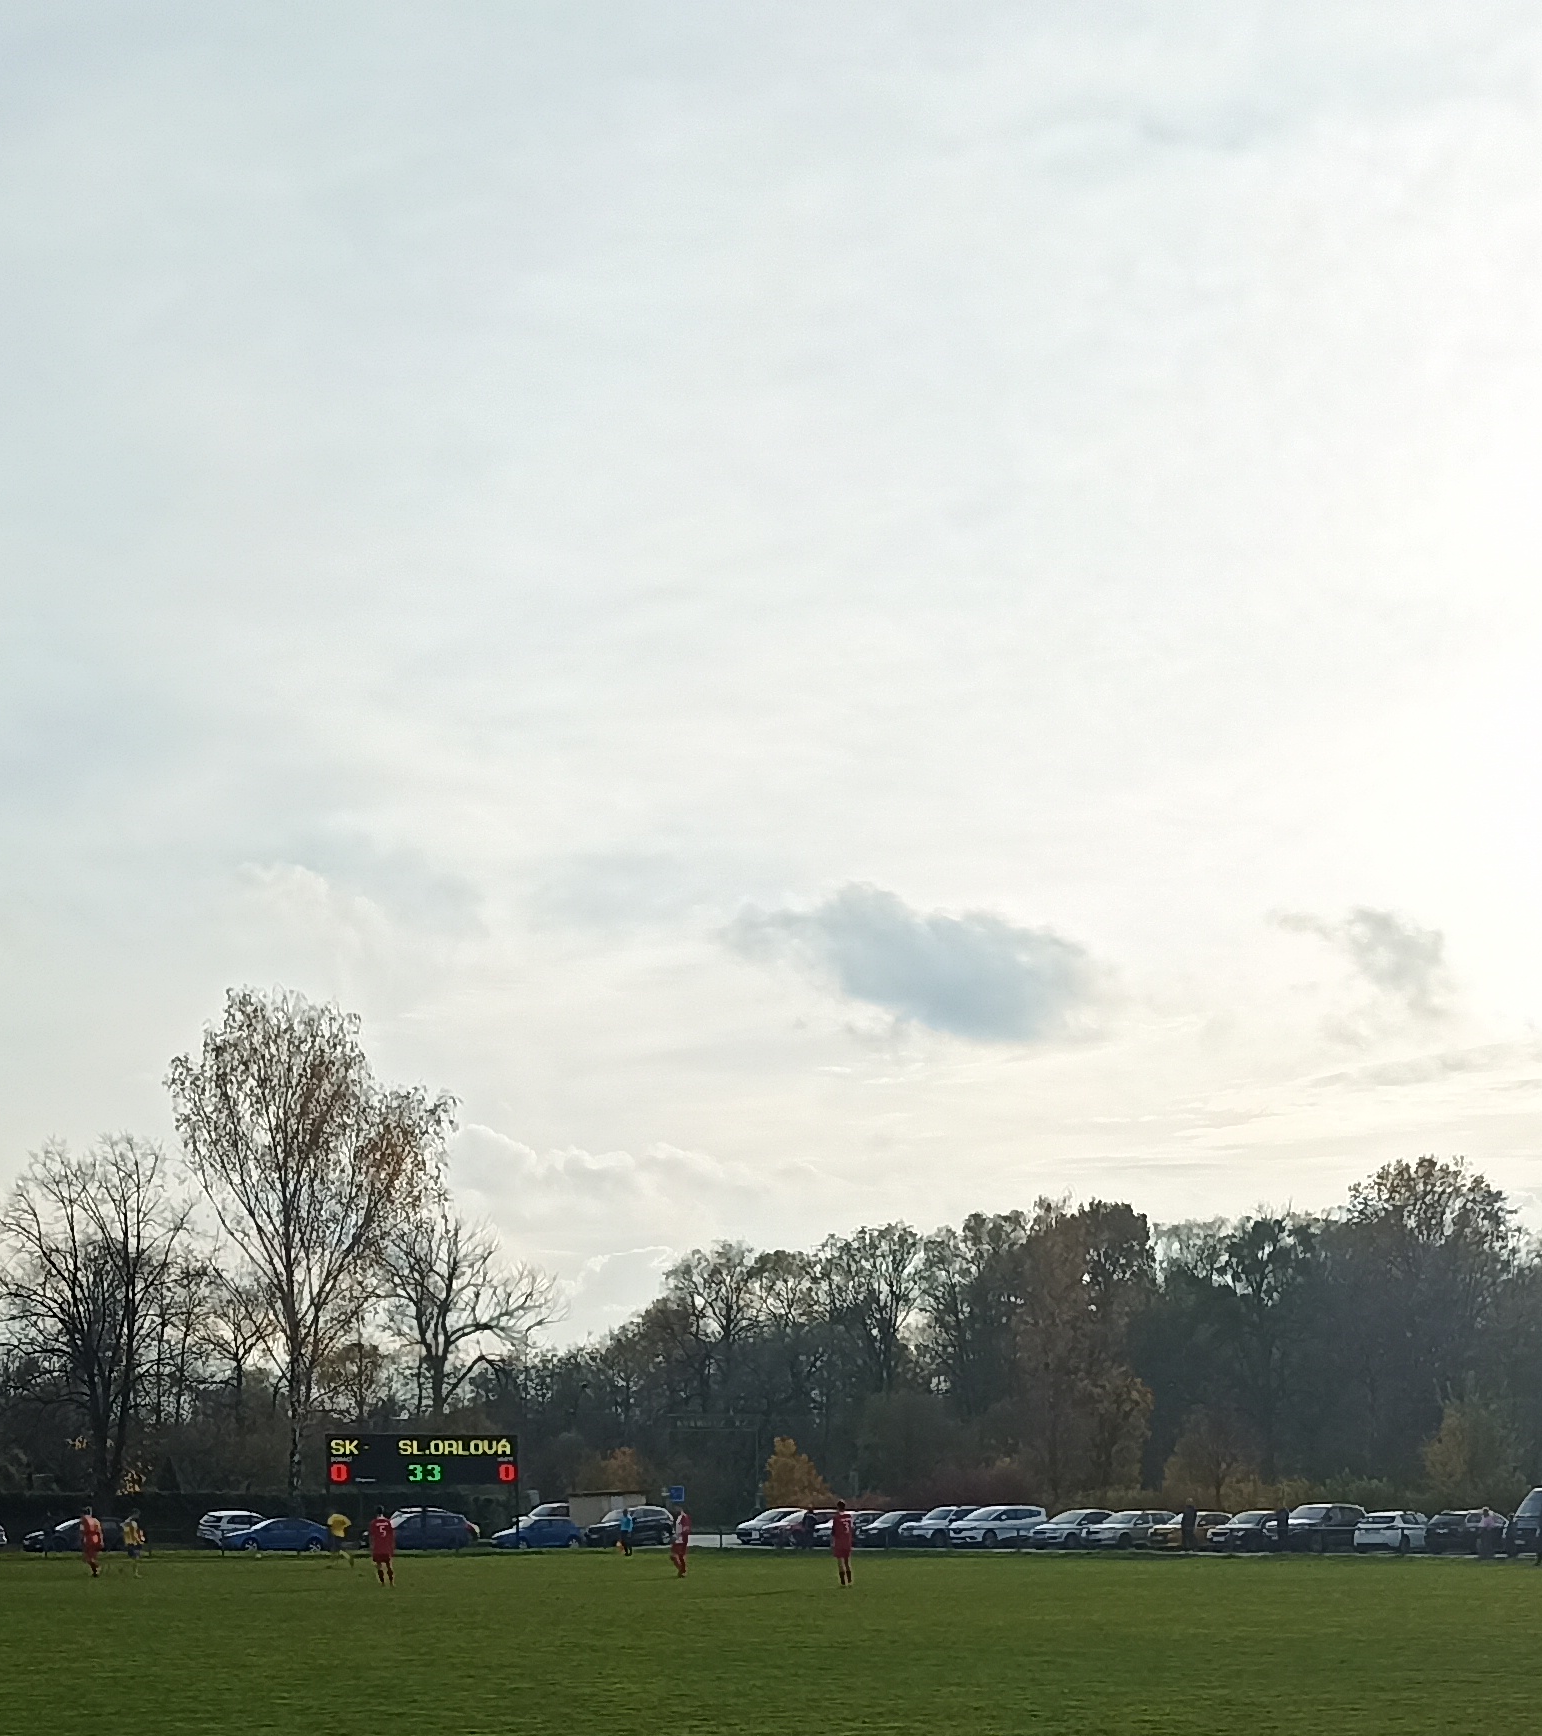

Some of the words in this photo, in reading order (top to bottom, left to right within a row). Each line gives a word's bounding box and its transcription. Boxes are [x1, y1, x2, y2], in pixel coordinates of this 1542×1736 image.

[331, 1464, 348, 1481] 0
[408, 1464, 442, 1481] 33
[499, 1464, 515, 1481] 0
